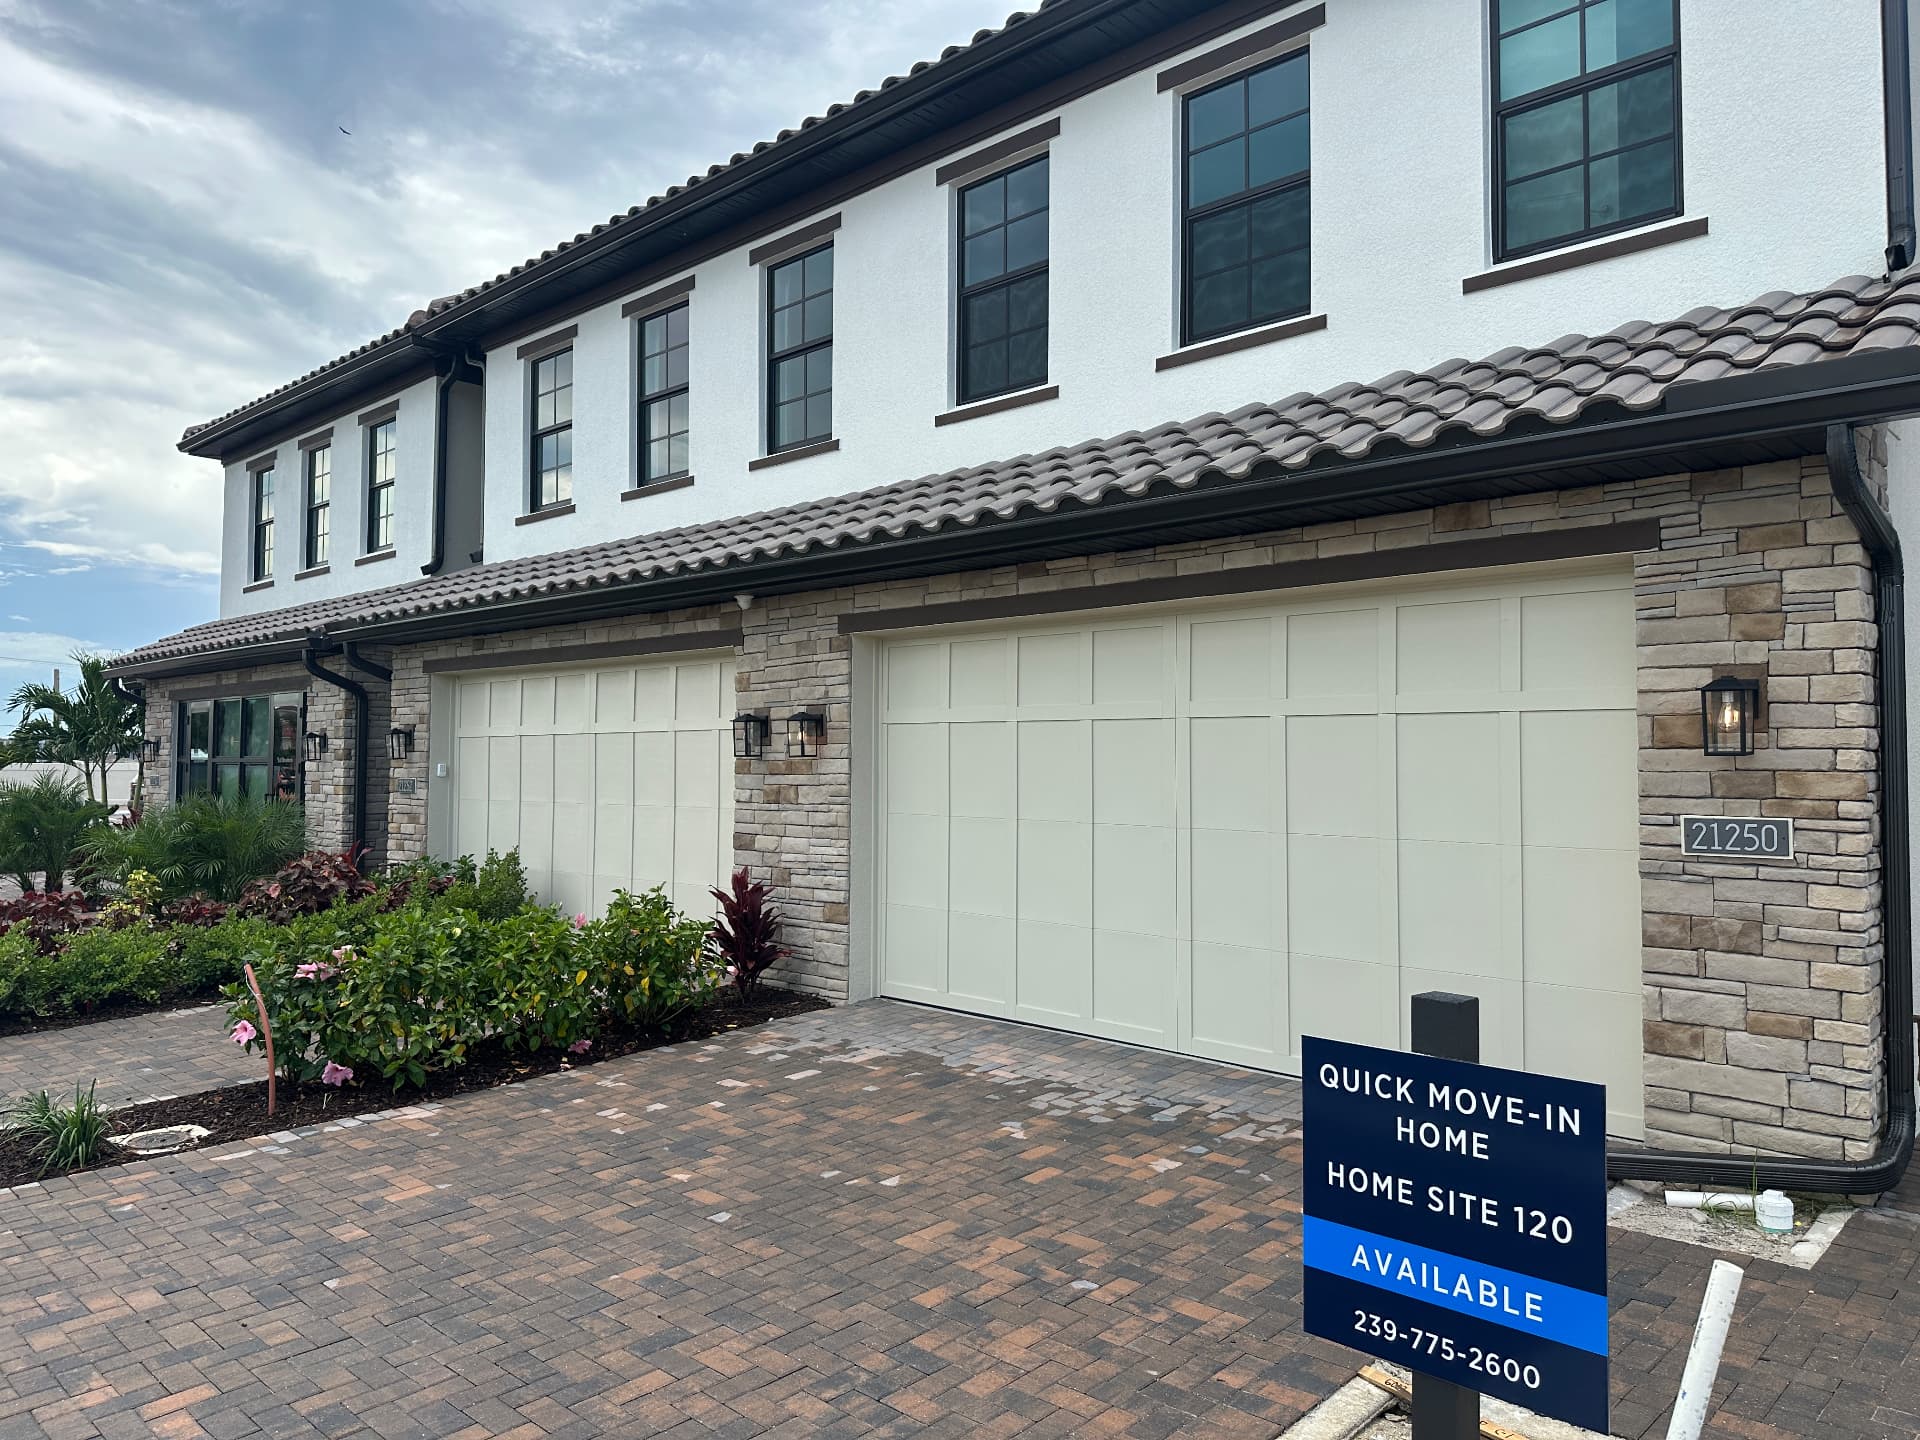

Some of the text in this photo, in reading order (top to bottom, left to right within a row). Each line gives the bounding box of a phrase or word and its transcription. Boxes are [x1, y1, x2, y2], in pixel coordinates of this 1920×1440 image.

[1691, 822, 1778, 852] 21250
[1319, 1063, 1580, 1136] QUICK MOVE-IN
[1397, 1116, 1489, 1160] HOME
[1328, 1161, 1573, 1244] HOME SITE 120
[1351, 1244, 1543, 1322] AVAILABLE
[1354, 1310, 1540, 1389] 239-775-2600
